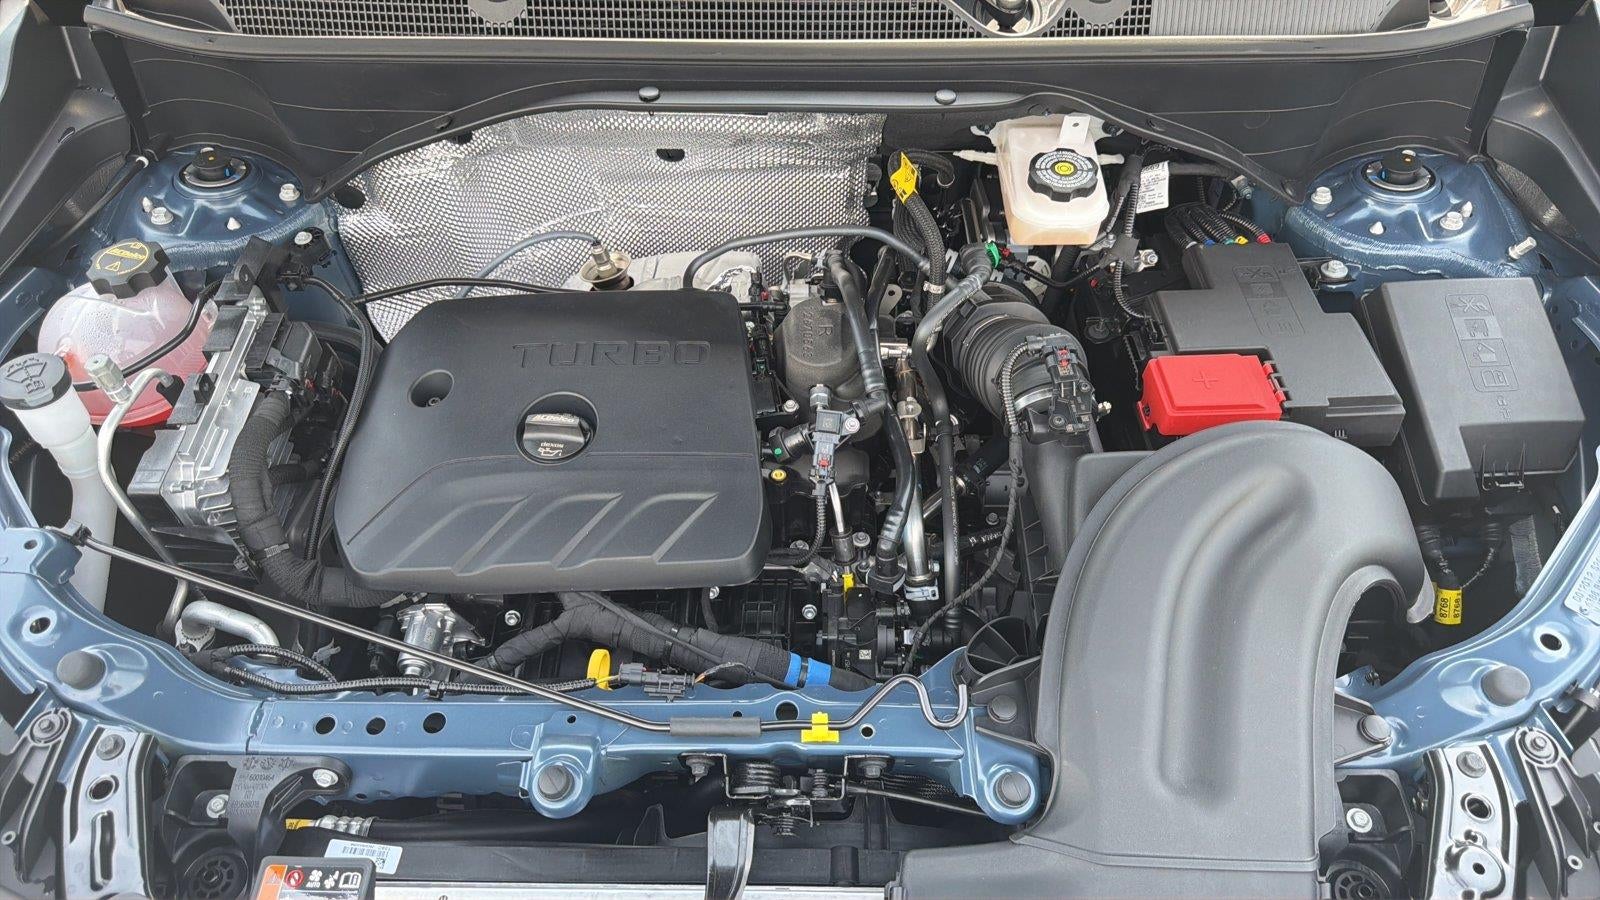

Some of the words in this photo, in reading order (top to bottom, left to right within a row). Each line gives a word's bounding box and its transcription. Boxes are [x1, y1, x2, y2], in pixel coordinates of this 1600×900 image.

[512, 341, 711, 368] TURBO
[1439, 597, 1449, 619] 8768
[1452, 597, 1461, 619] 8768
